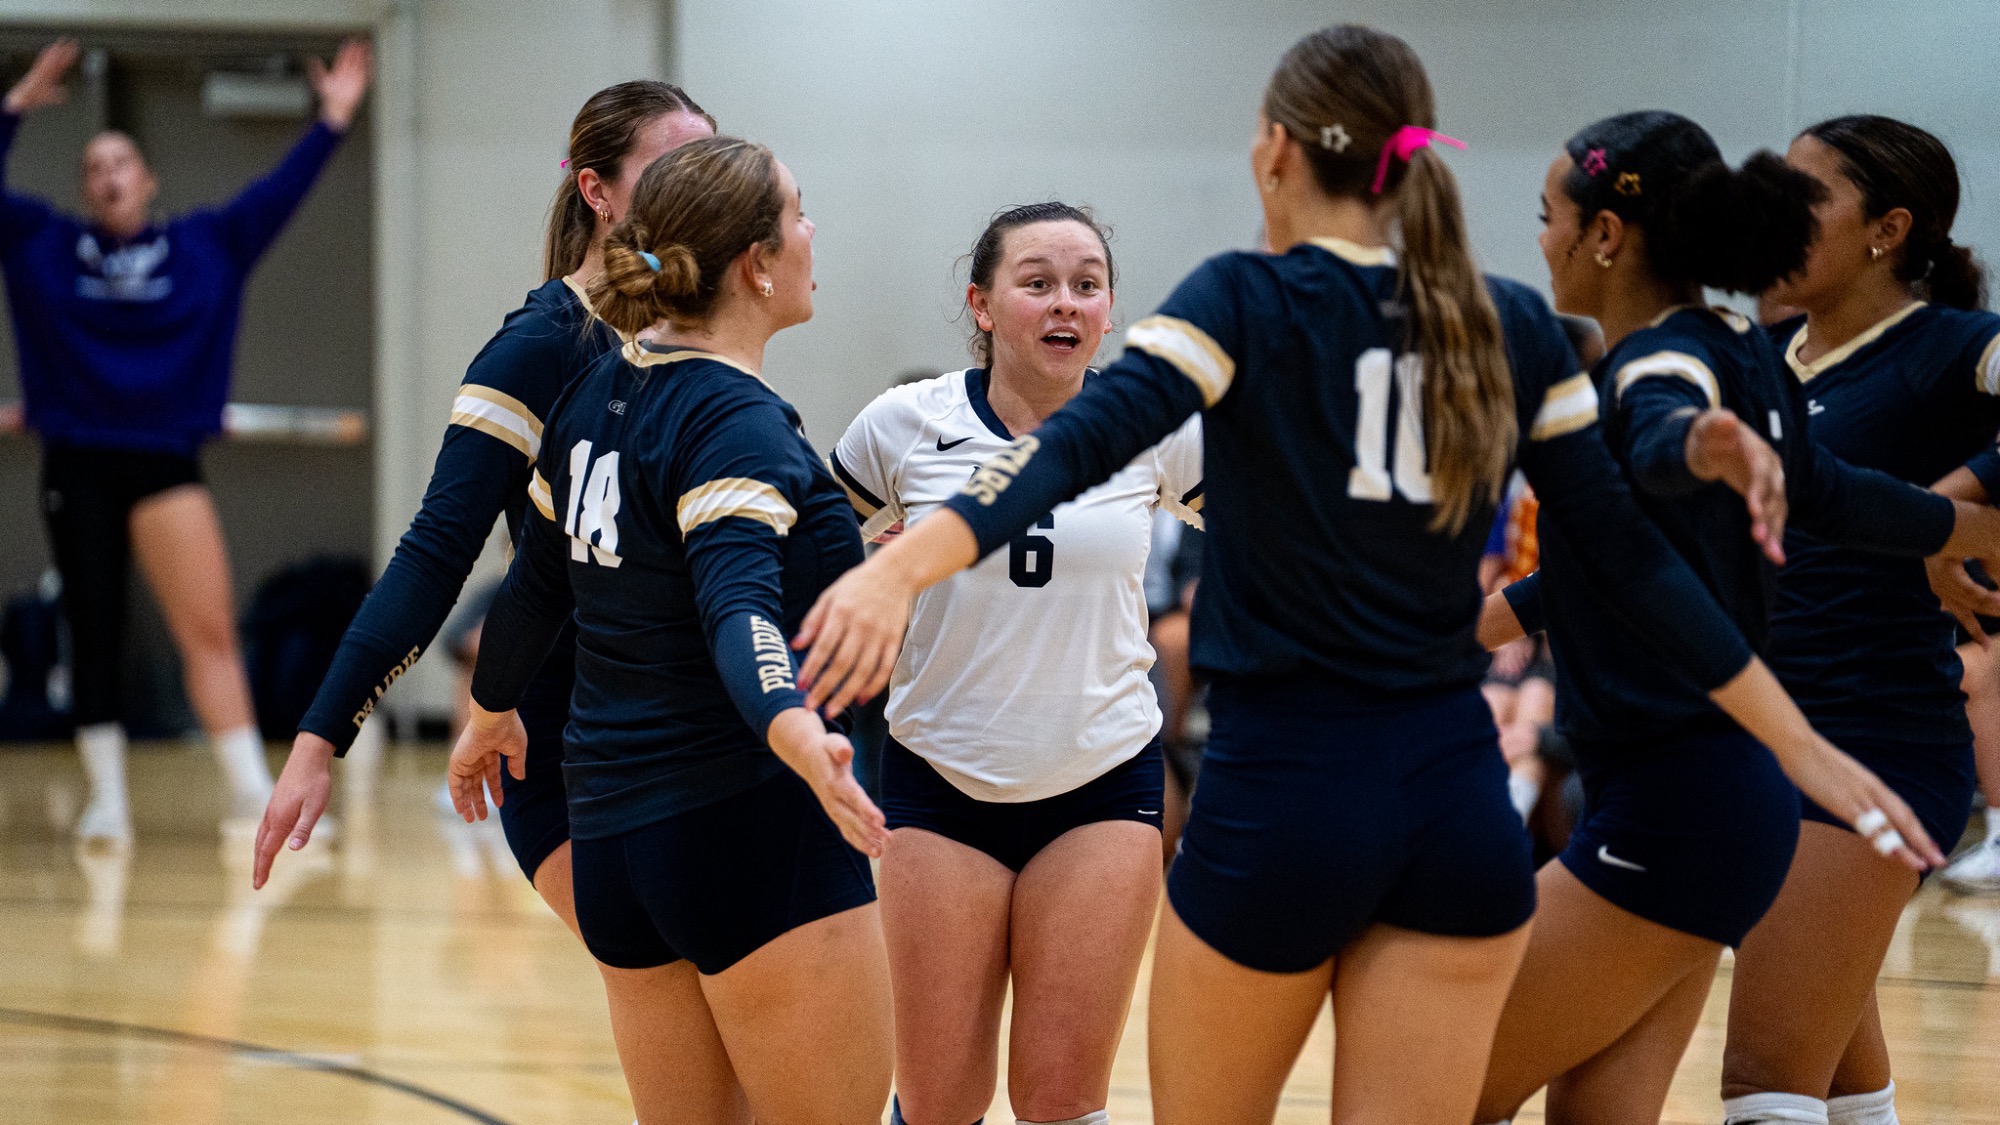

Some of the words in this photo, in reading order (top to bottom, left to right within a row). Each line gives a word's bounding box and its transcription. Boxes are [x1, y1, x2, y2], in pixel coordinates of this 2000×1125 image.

[565, 439, 624, 568] 18
[1009, 511, 1055, 588] 6
[750, 615, 797, 693] PRAIRIE
